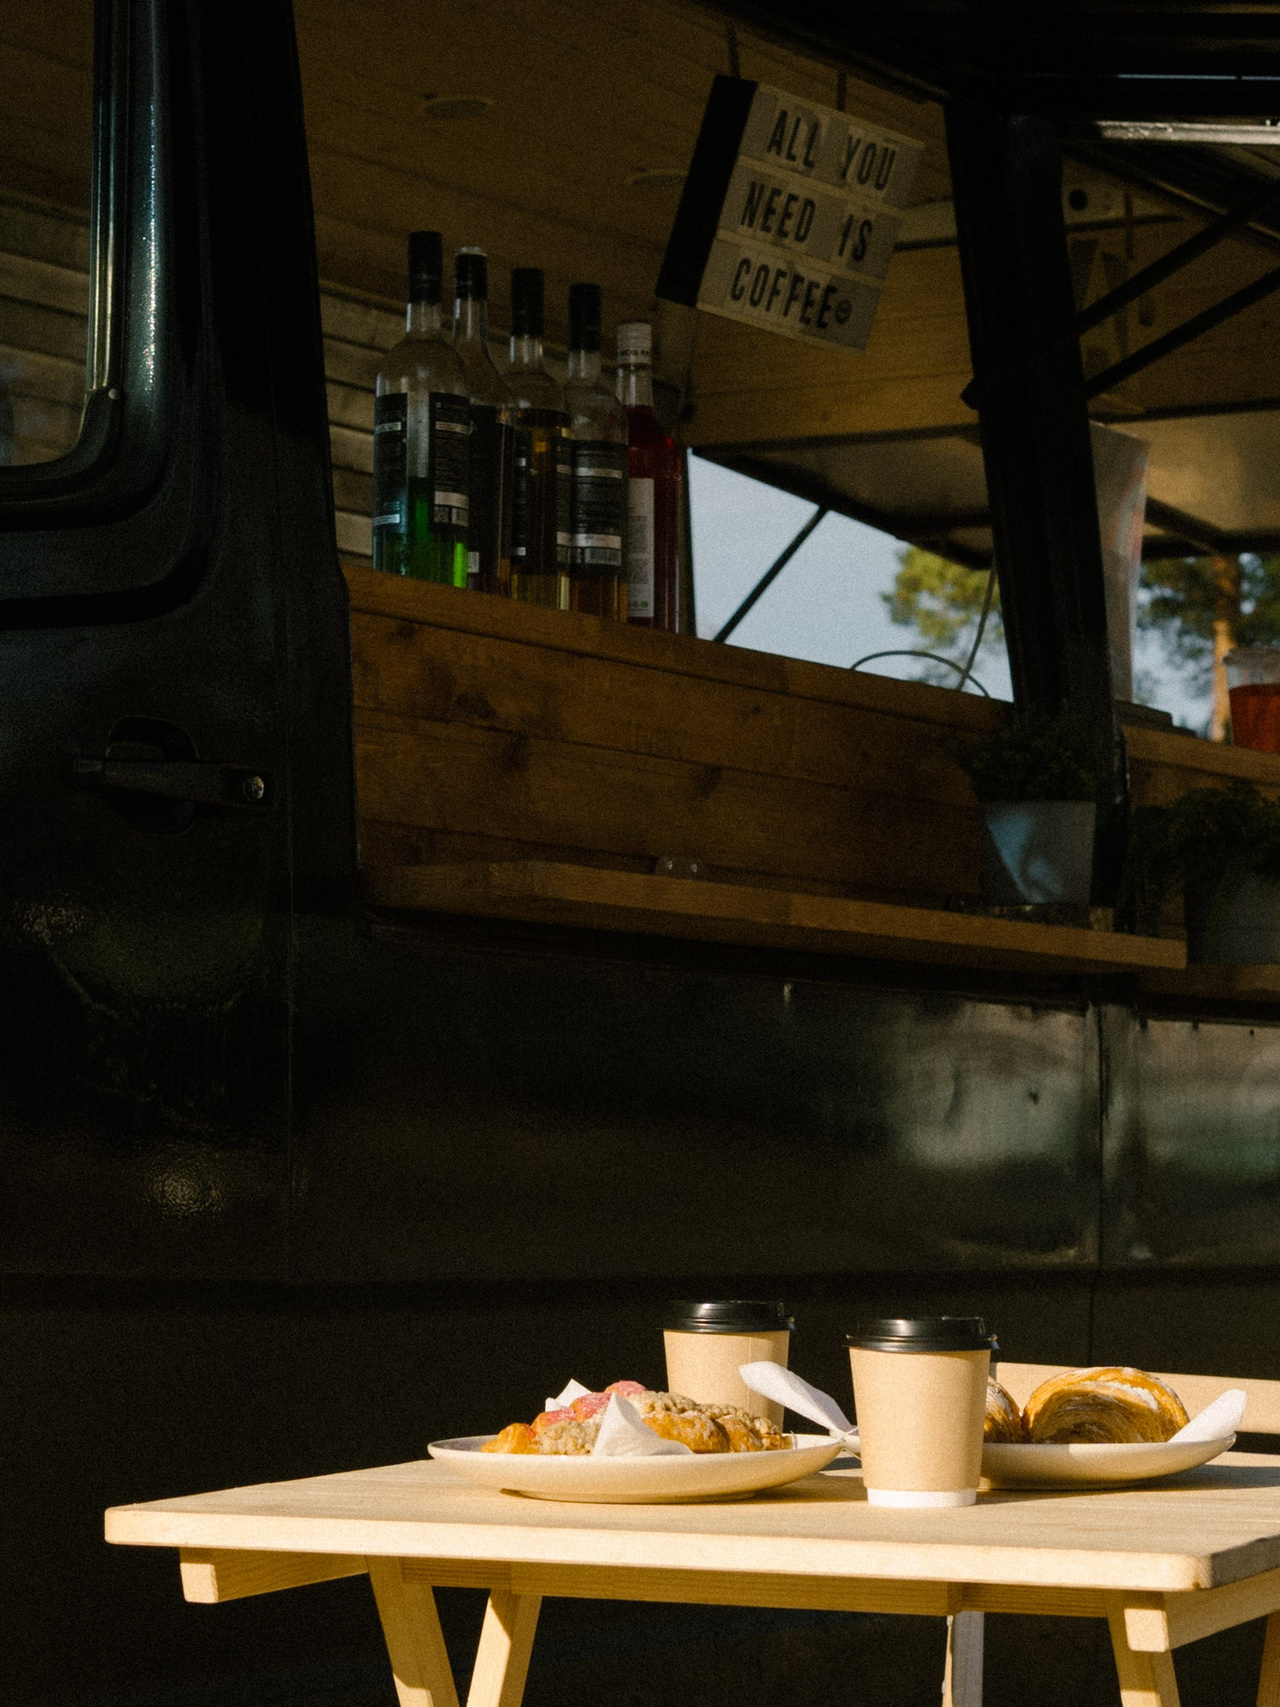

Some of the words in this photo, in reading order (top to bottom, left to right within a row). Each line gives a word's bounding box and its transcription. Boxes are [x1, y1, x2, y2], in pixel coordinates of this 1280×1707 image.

[768, 109, 821, 168] ALL
[841, 135, 896, 190] YOU
[740, 181, 816, 243] NEED
[839, 213, 873, 262] IS
[731, 257, 838, 329] COFFEE
